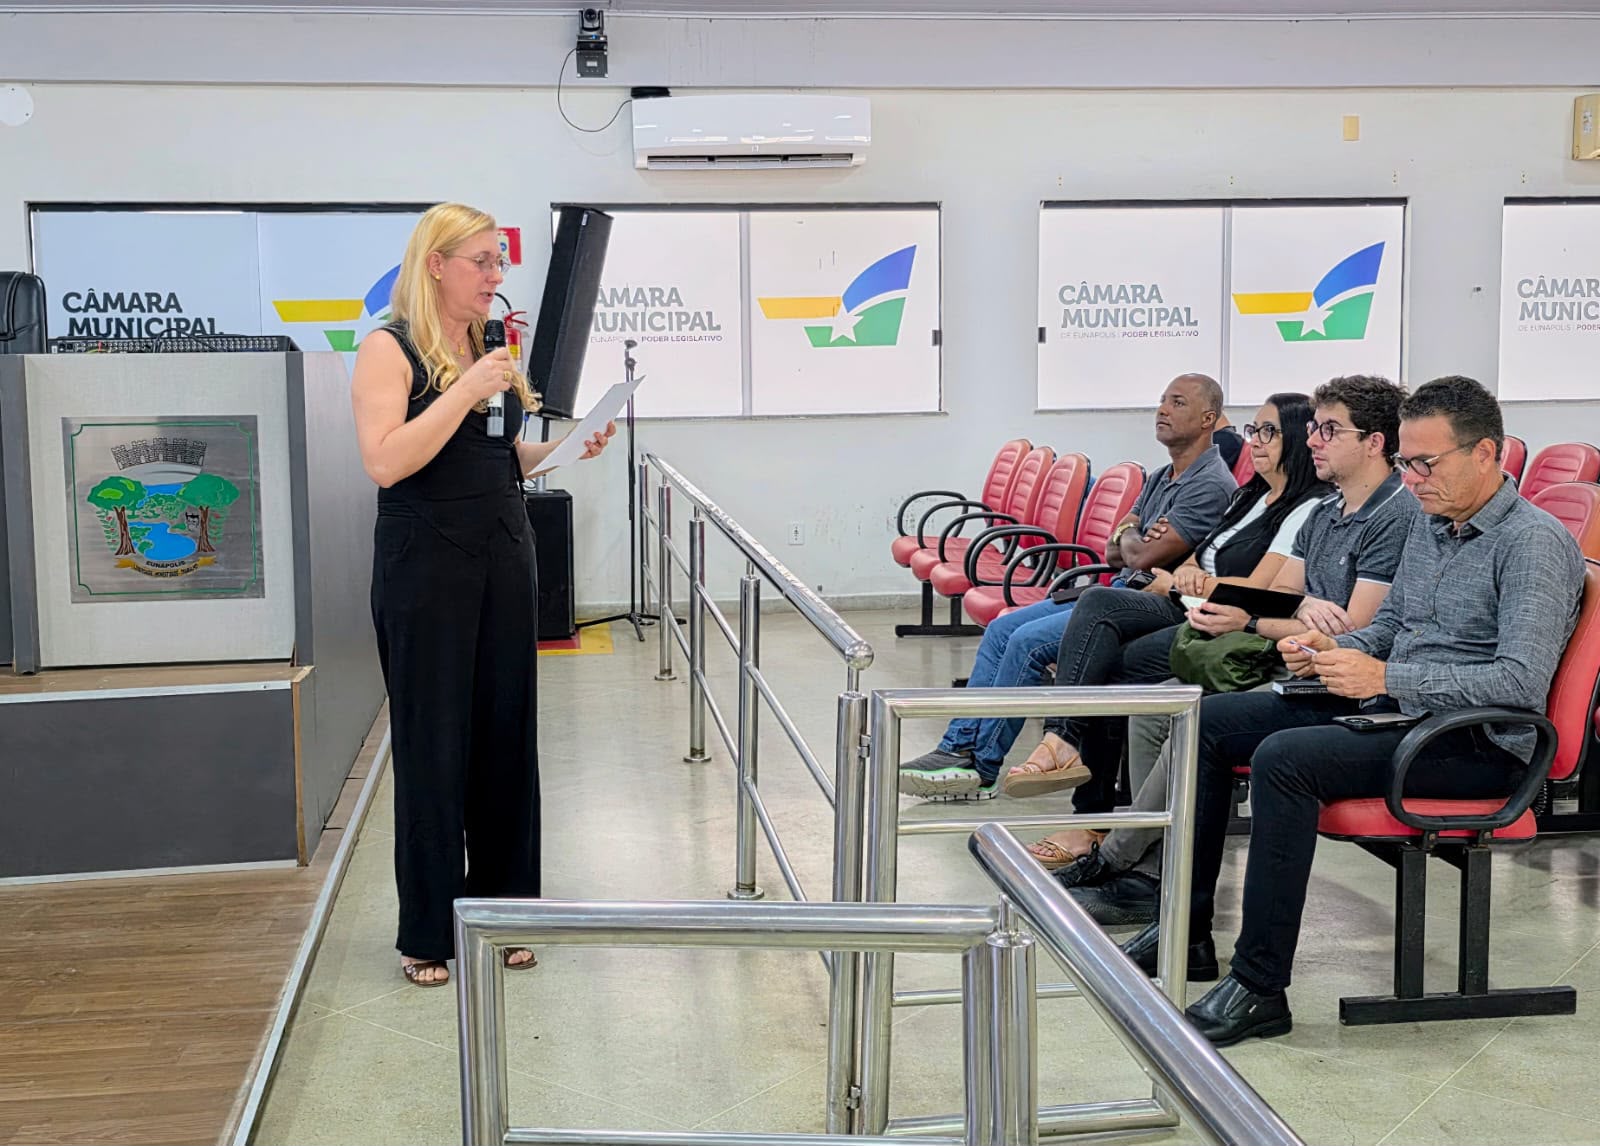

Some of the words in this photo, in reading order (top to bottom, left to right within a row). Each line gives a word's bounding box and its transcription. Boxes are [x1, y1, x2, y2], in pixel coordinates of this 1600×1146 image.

[597, 284, 684, 307] ÂMARA
[1058, 281, 1163, 305] CÂMARA
[1517, 275, 1600, 298] CÂMAR
[62, 288, 183, 313] CÂMARA
[1519, 301, 1600, 321] MUNIC
[67, 317, 225, 337] MUNICIPAL
[1061, 306, 1198, 329] MUNICIPAL
